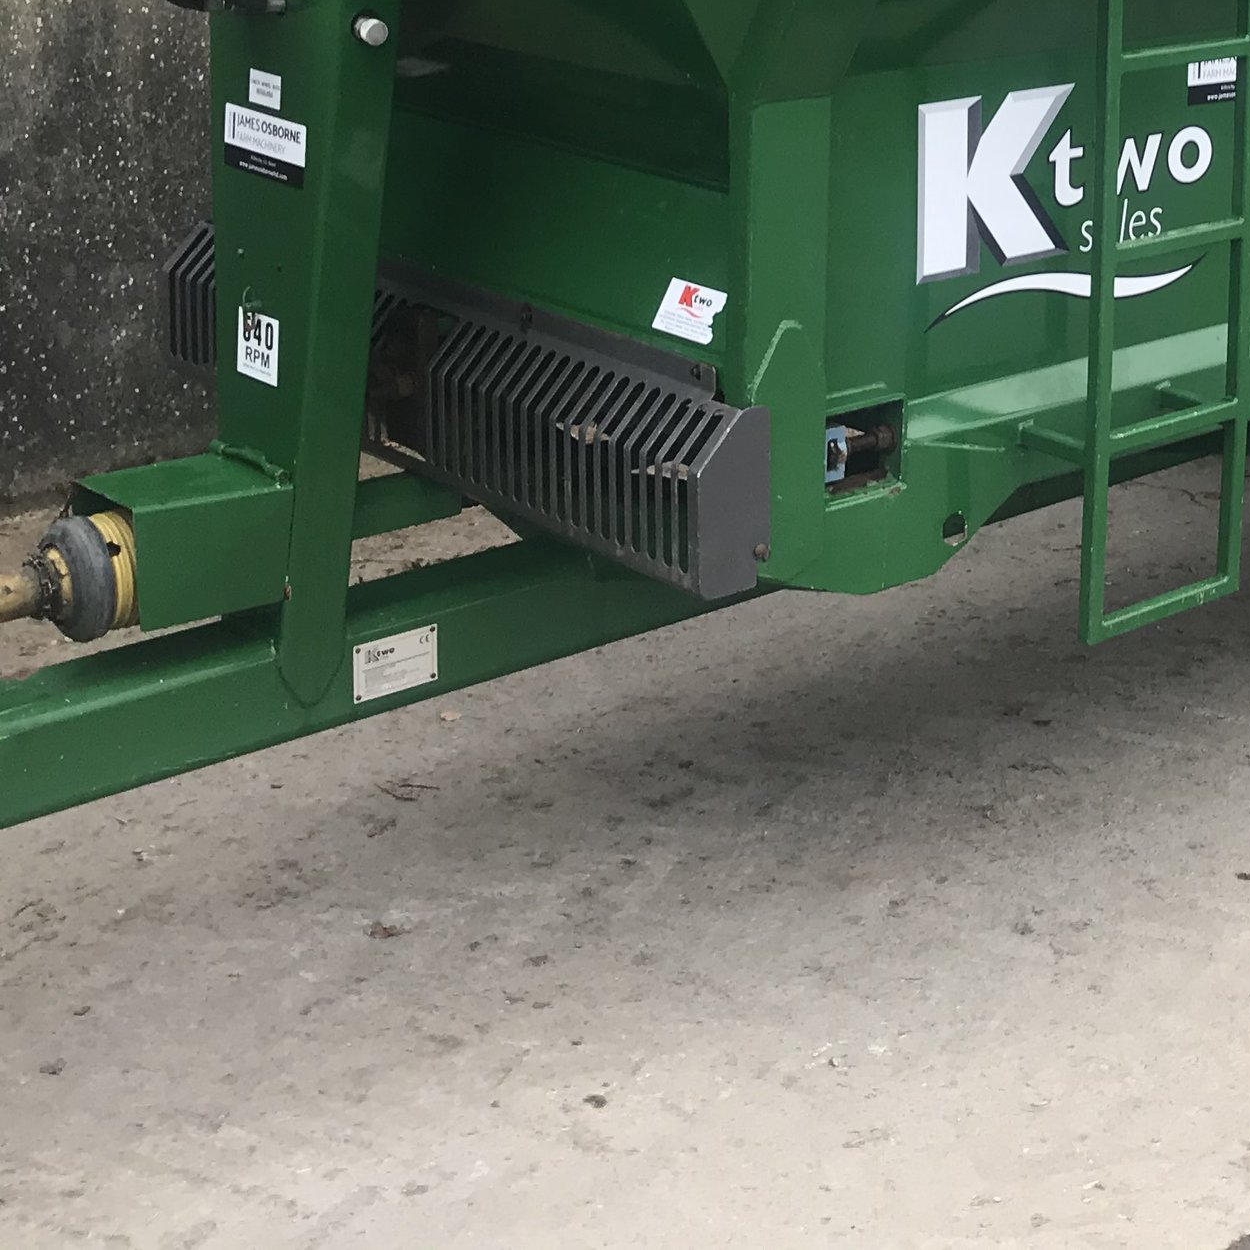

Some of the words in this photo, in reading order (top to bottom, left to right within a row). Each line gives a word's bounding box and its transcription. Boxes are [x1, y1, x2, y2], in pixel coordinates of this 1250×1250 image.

[237, 113, 261, 132] JAMES
[260, 120, 301, 144] OSBORNE
[252, 137, 286, 155] MACHINERY
[1079, 198, 1163, 253] sles
[245, 346, 270, 369] RPM
